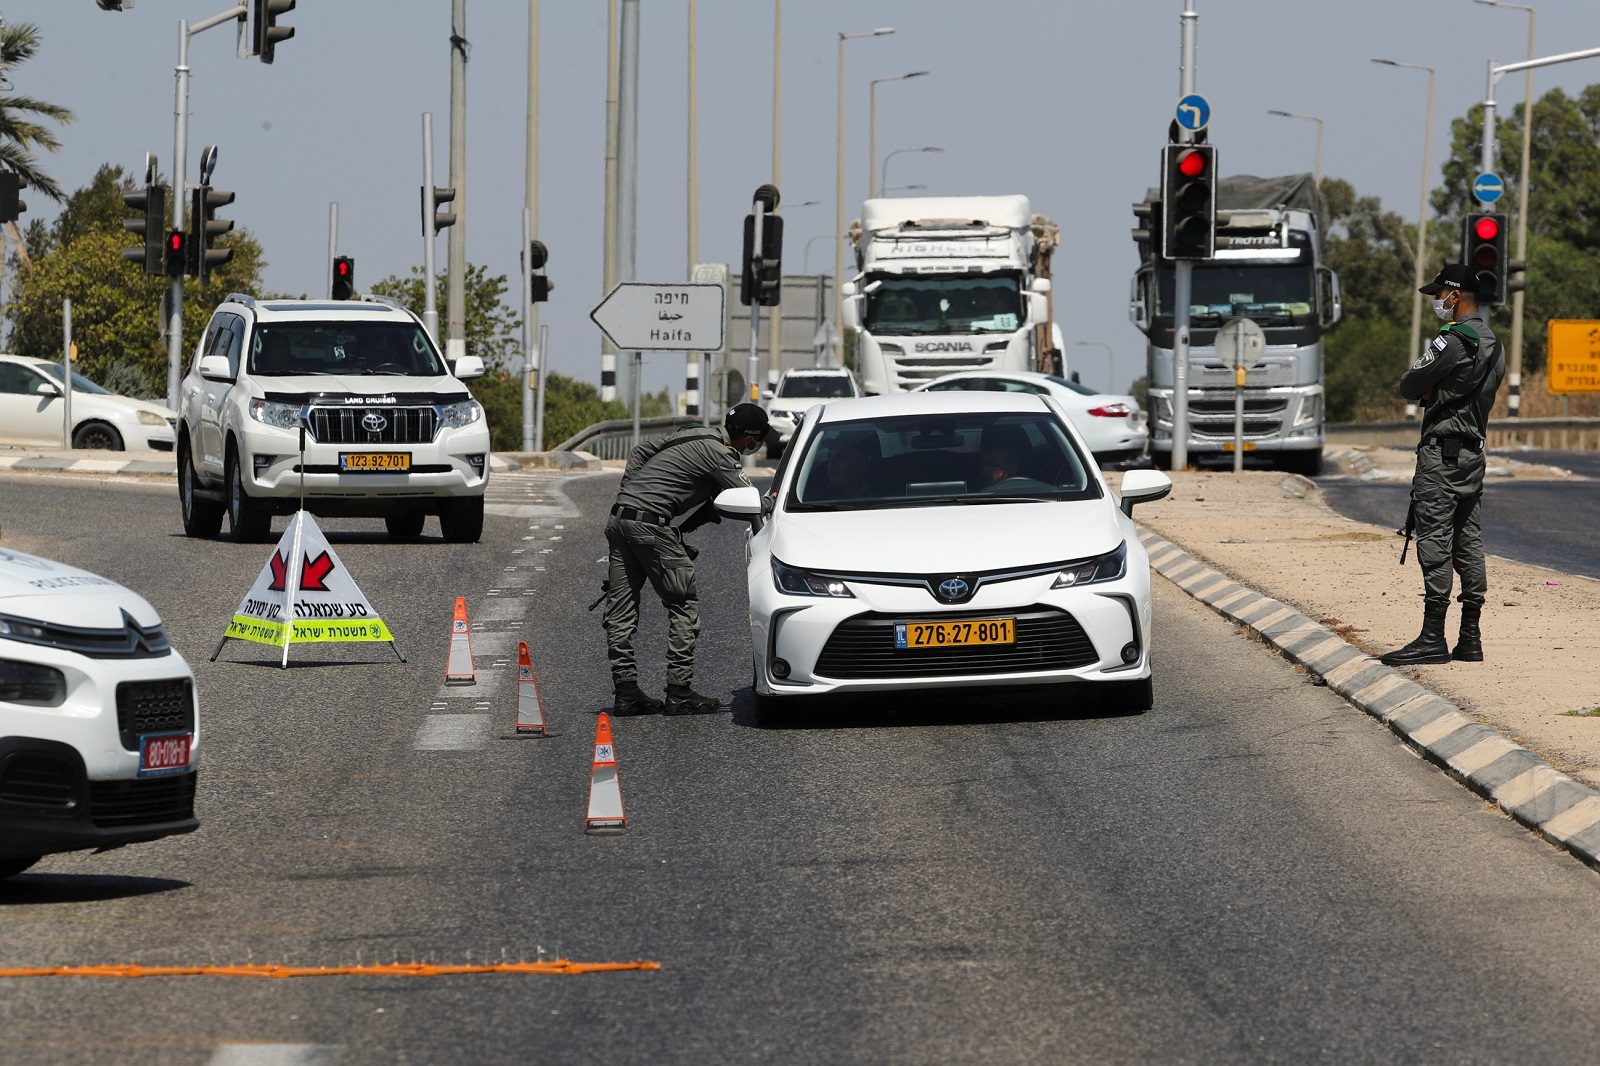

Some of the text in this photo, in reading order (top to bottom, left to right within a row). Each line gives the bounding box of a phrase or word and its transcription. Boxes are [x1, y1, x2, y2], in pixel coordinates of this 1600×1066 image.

[654, 292, 689, 305] חיפה
[658, 310, 683, 323] حيفا
[650, 329, 692, 341] Haifa
[914, 342, 973, 353] SCANIA
[344, 396, 397, 404] LAND CRUISER
[243, 598, 282, 619] סע ימינה
[293, 599, 368, 618] סע שמאלה
[249, 625, 274, 640] משטרת
[292, 624, 367, 638] משטרת ישראל
